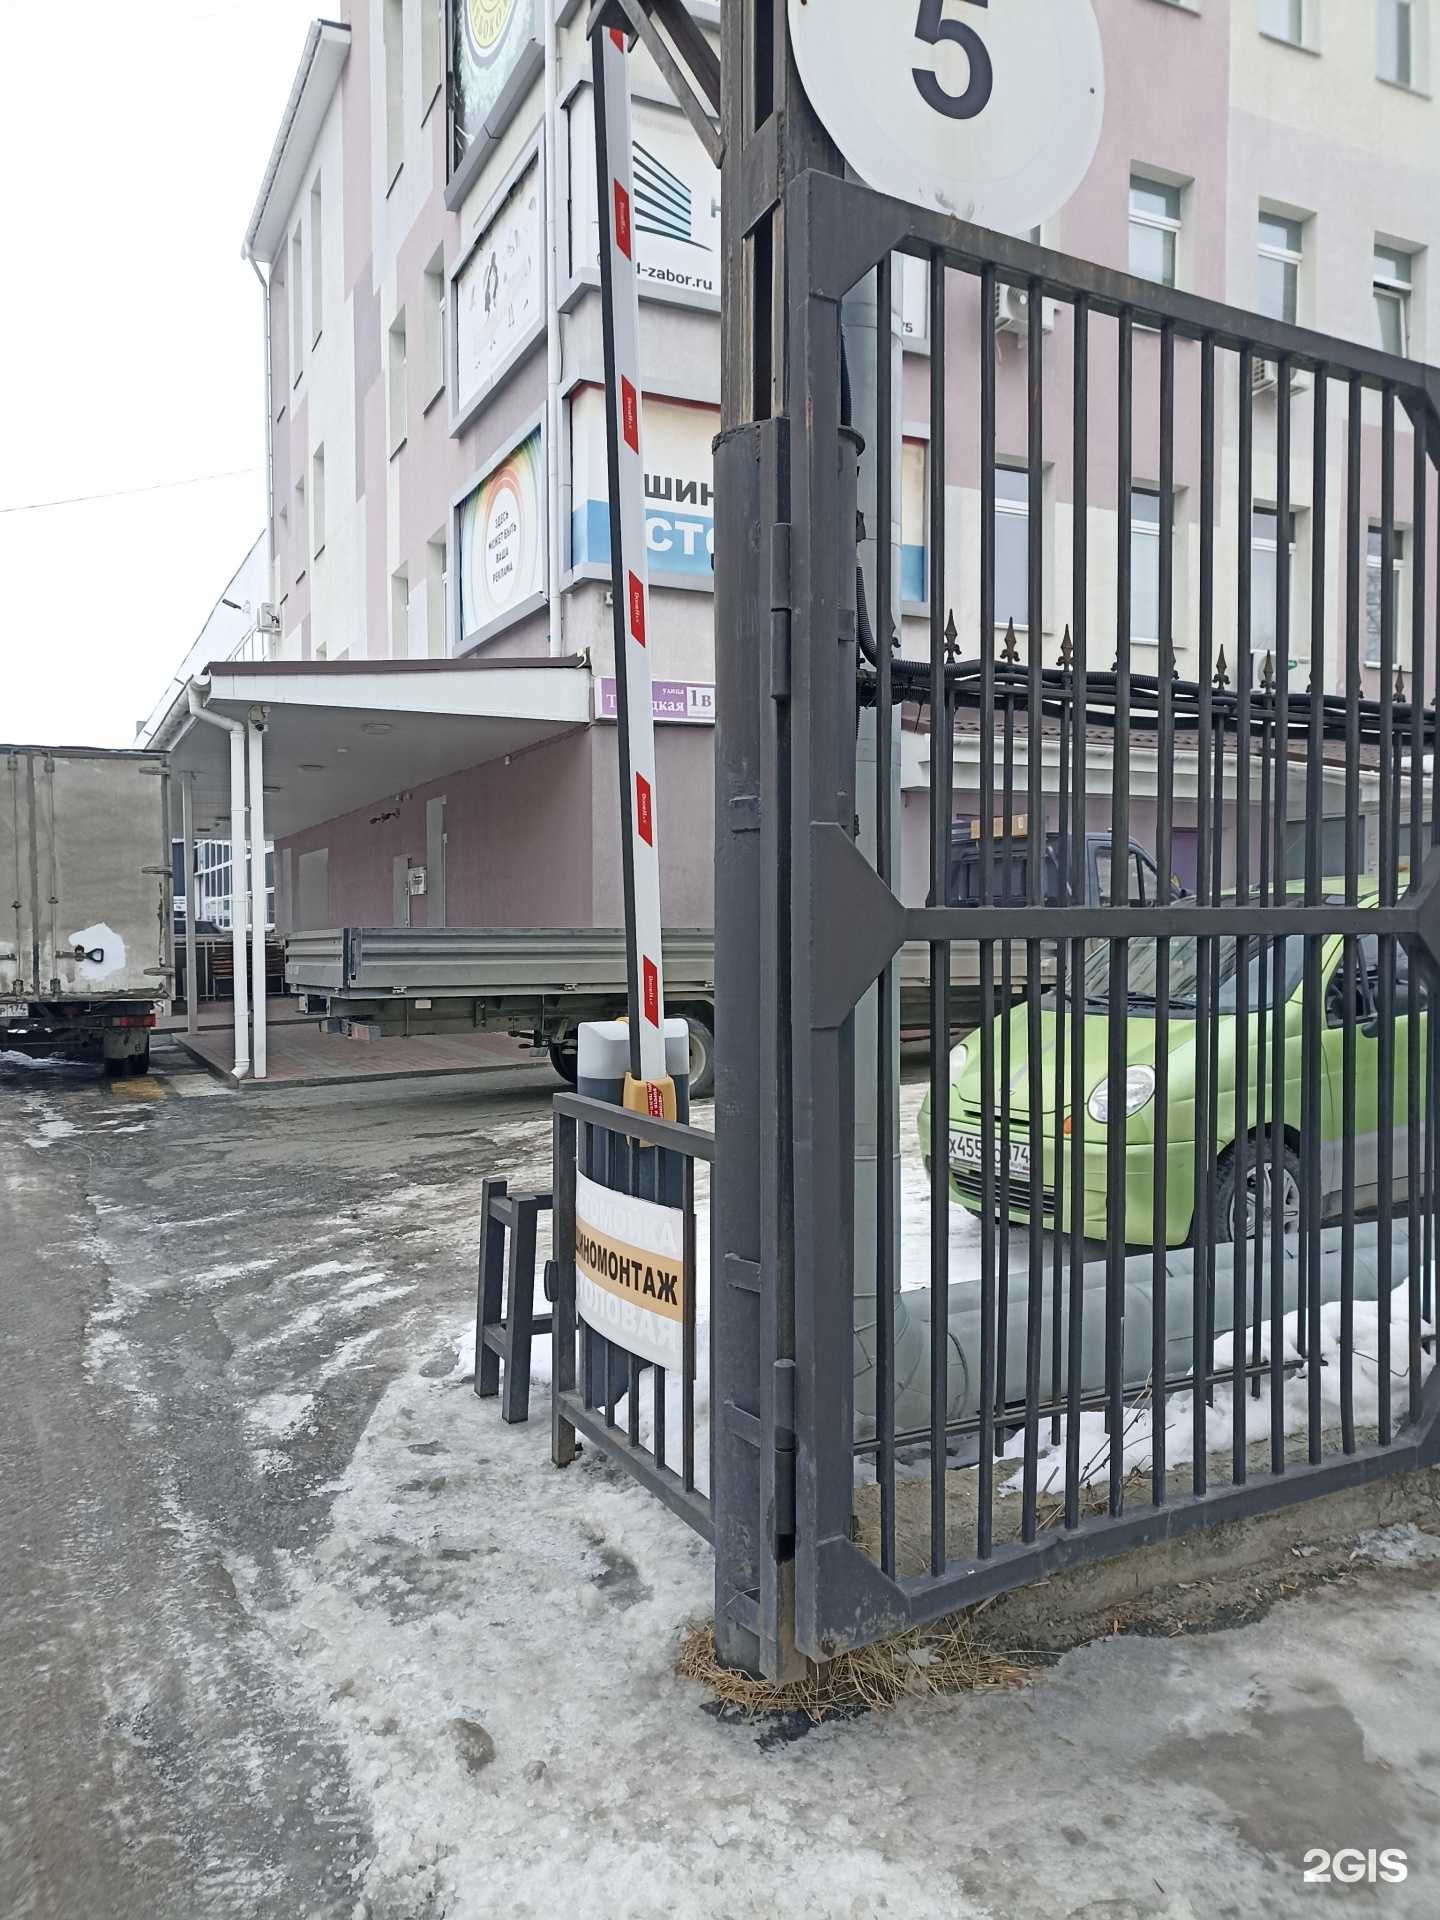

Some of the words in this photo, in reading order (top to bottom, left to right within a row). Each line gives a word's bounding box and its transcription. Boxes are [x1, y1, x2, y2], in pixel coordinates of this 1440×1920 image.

[912, 0, 993, 119] 5
[495, 547, 509, 564] ВАША
[492, 562, 513, 584] РЕКЛАМА
